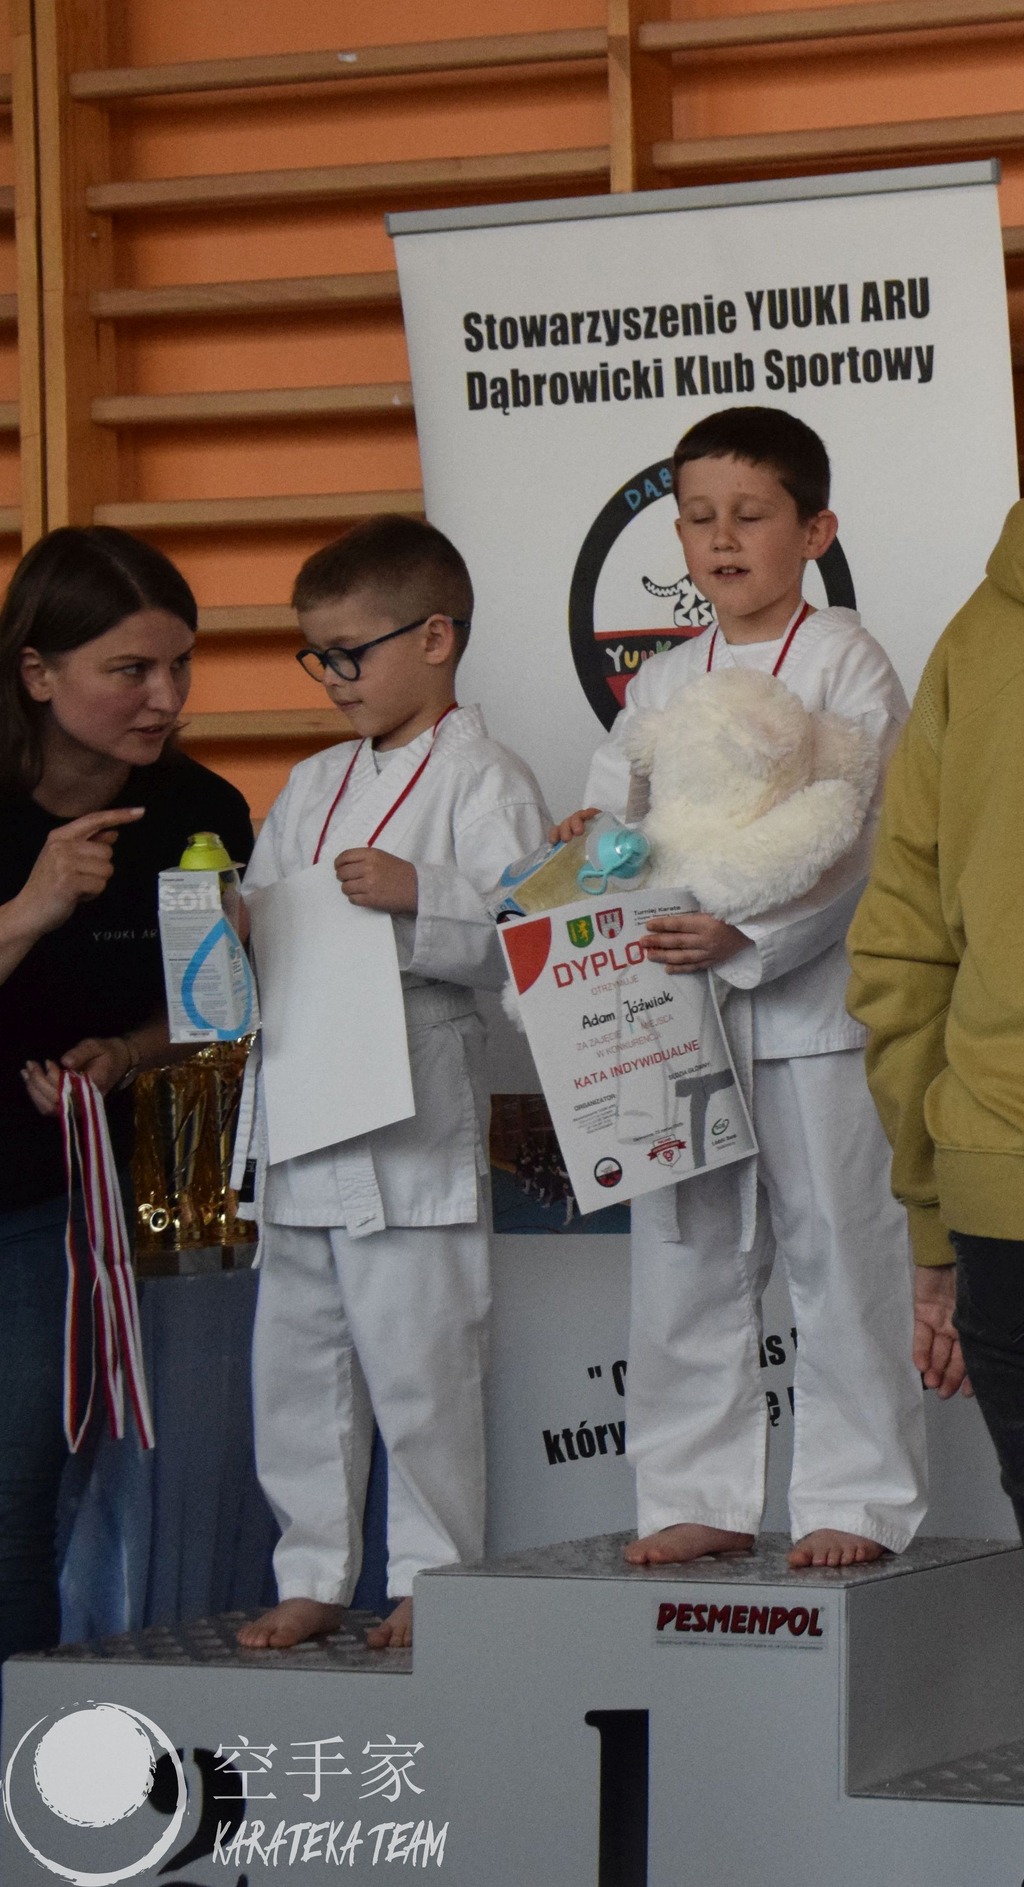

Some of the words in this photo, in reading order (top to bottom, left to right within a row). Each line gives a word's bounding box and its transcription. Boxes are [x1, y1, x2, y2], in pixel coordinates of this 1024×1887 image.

[463, 295, 737, 352] Stowarzyszenie
[745, 283, 849, 331] YUUKI
[861, 277, 930, 322] ARU
[466, 359, 664, 416] Dąbrowicki
[675, 352, 754, 396] Klub
[765, 344, 935, 393] Sportowy
[93, 929, 135, 941] YUUKI
[553, 941, 645, 988] DYPLO
[582, 1012, 616, 1030] Adam
[623, 991, 674, 1023] Jóźwiak
[574, 1070, 608, 1089] KATA
[610, 1039, 700, 1077] INDYWIDUALNE
[656, 1602, 823, 1637] PESMENPOL
[585, 1709, 649, 1887] 1
